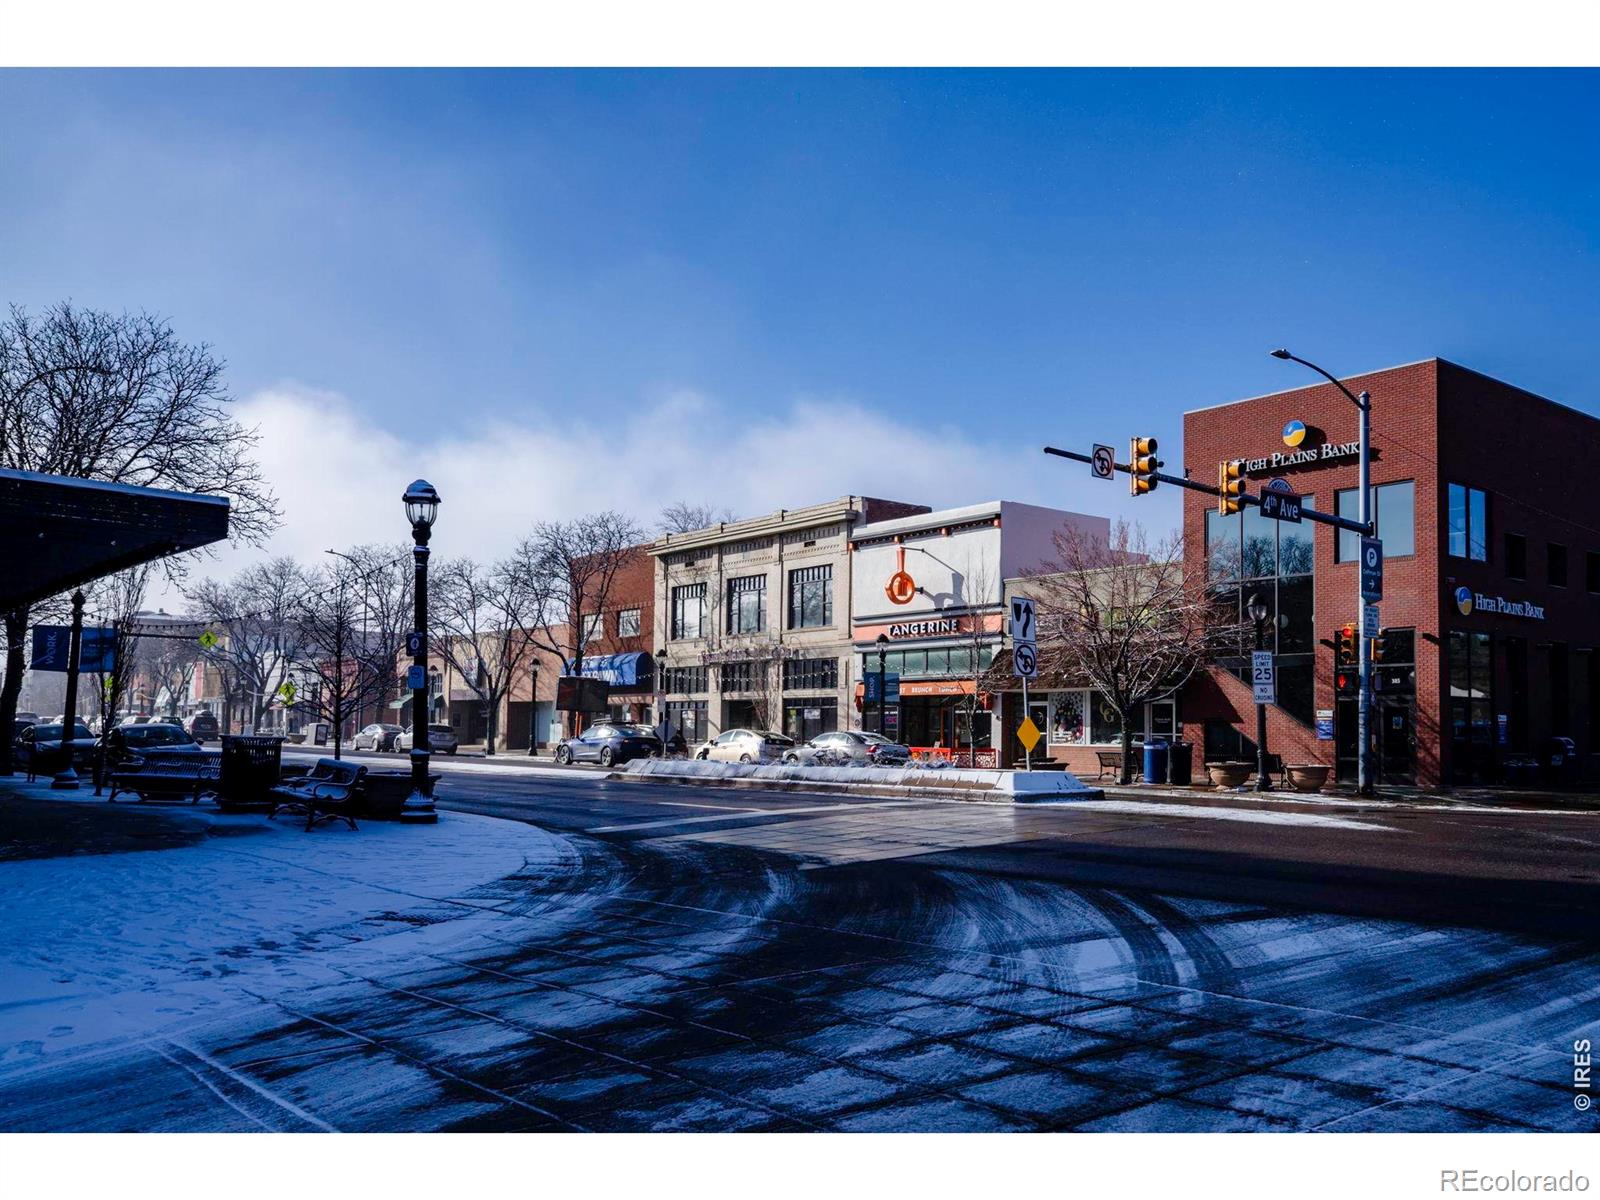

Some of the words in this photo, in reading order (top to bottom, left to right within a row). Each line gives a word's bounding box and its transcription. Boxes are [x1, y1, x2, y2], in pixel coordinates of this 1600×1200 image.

[1271, 449, 1318, 468] PLAINS
[1321, 441, 1361, 460] BANK
[1263, 495, 1278, 513] 4th
[1280, 498, 1299, 519] Ave
[1474, 593, 1496, 612] HIGH
[1496, 596, 1524, 616] PLAINS
[1523, 601, 1545, 619] BANK
[887, 619, 958, 635] TANGERINE
[1255, 668, 1271, 680] 25
